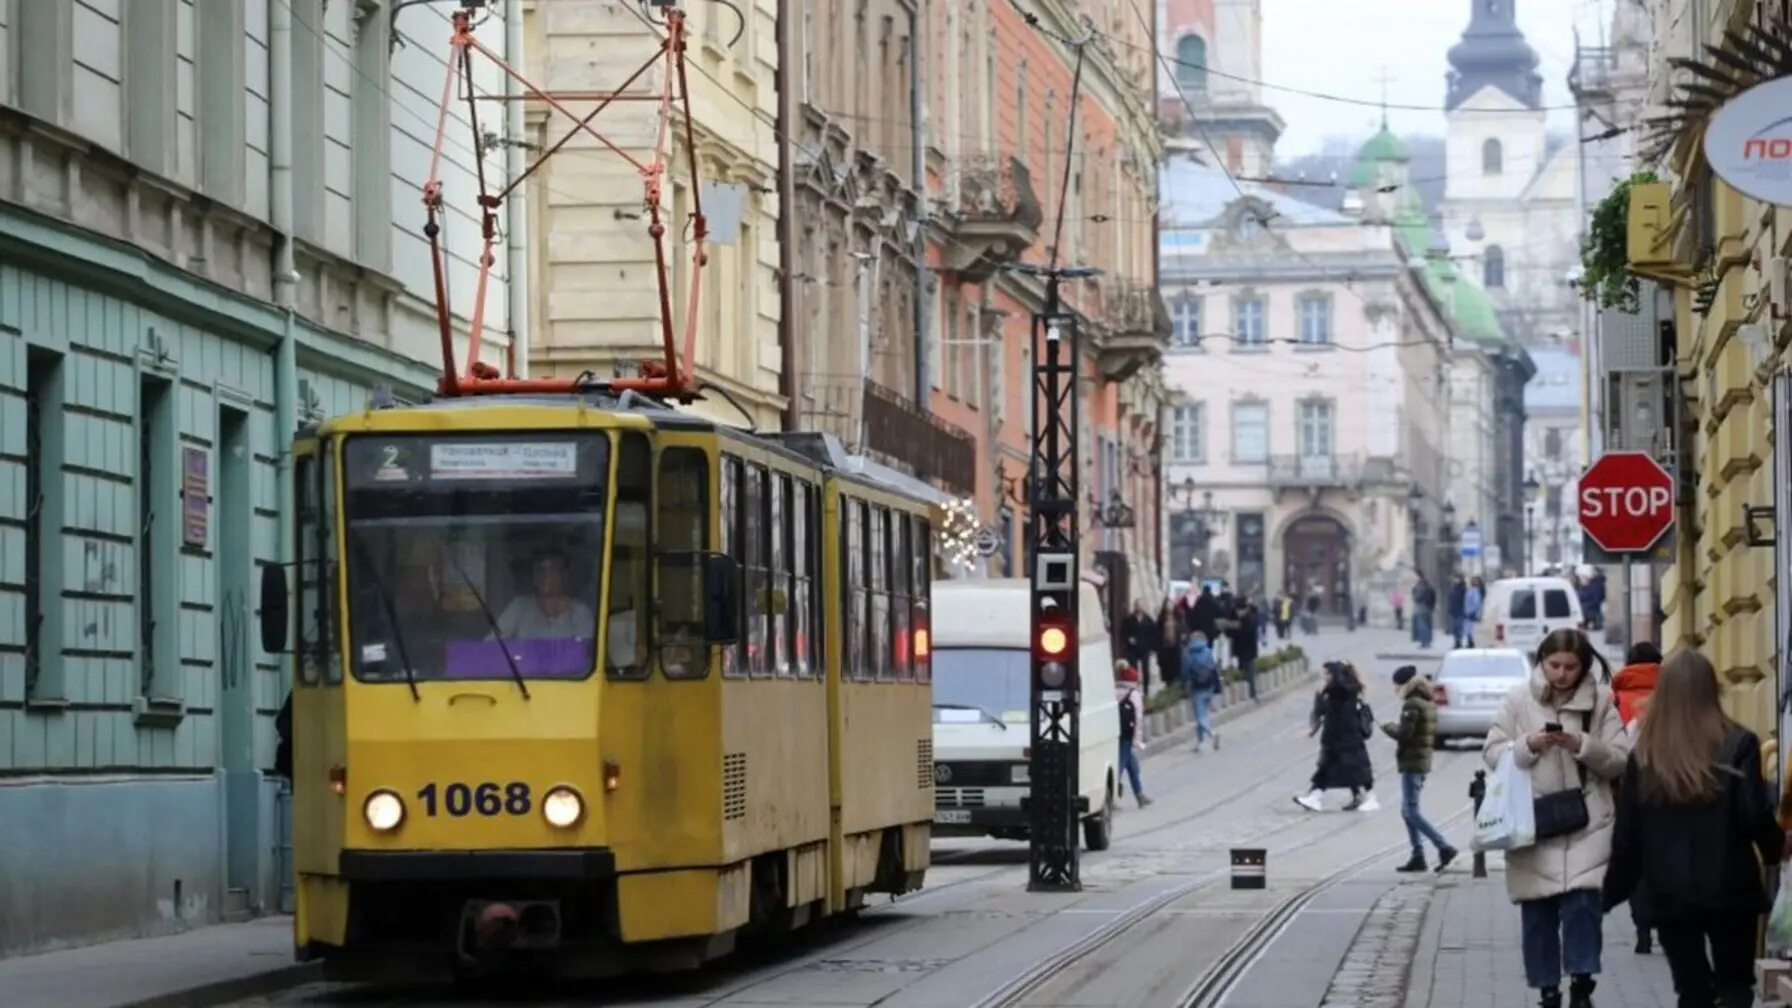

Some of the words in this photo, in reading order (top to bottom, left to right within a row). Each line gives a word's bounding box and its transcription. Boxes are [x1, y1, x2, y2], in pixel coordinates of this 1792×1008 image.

[383, 445, 399, 467] 2
[1582, 486, 1669, 517] STOP
[417, 782, 531, 817] 1068
